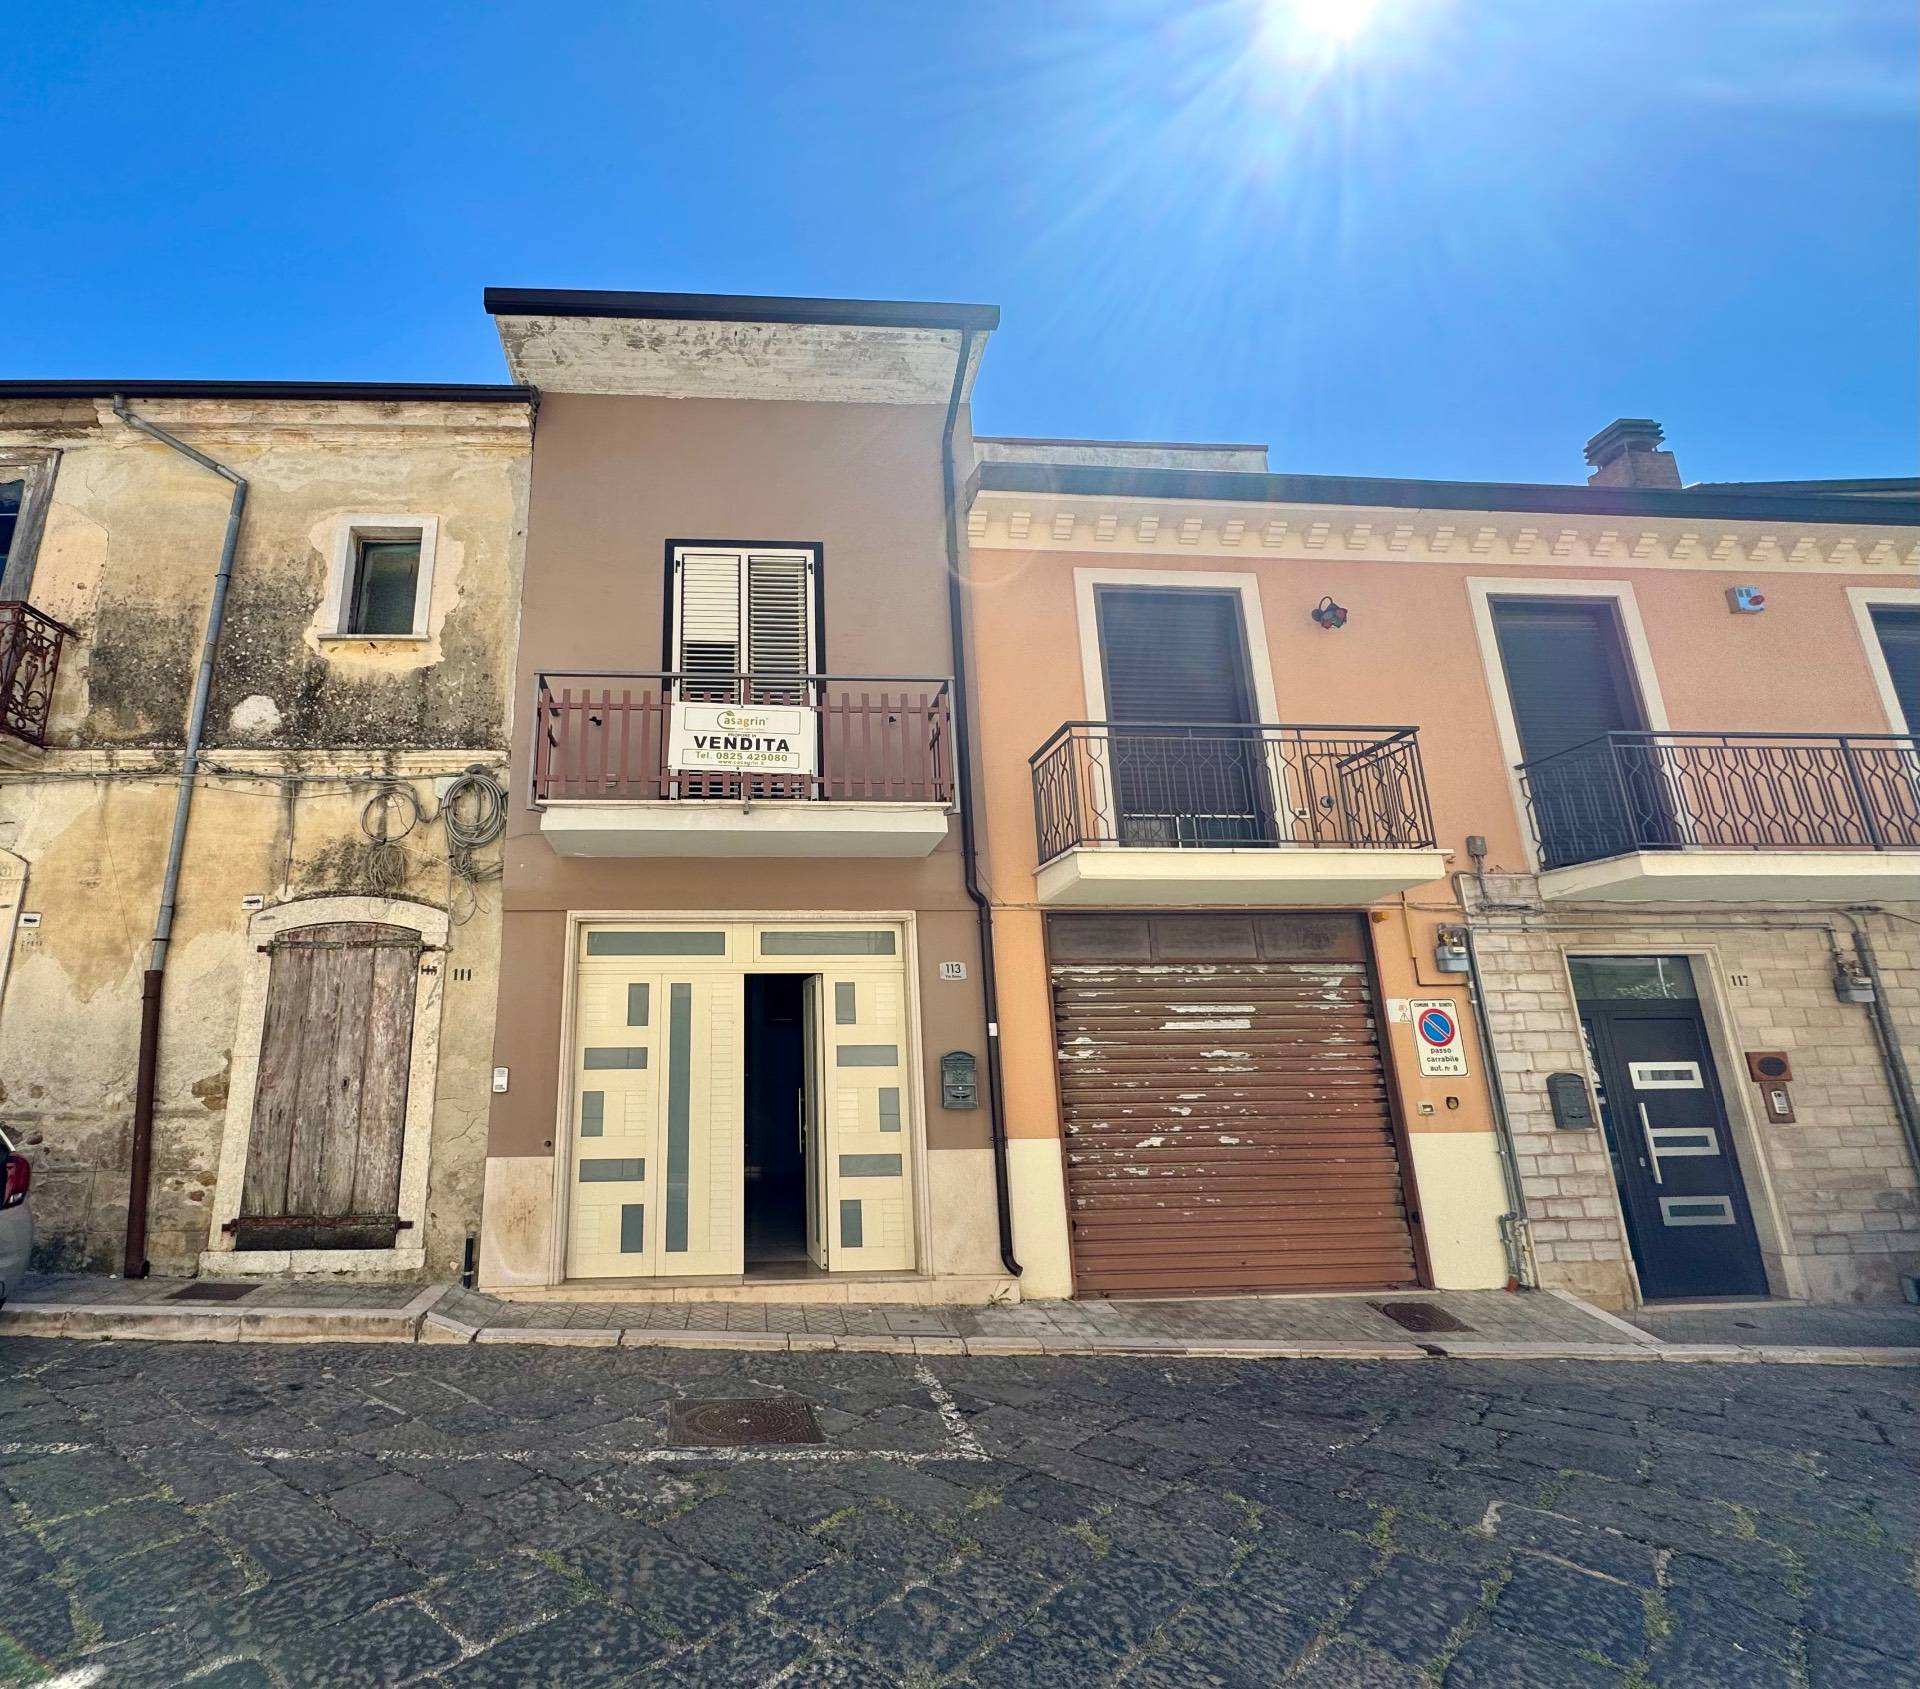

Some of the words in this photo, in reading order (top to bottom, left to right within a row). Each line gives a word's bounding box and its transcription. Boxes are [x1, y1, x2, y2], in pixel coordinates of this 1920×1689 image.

[693, 735, 790, 752] VENDITA
[696, 751, 712, 759] Tel.
[716, 752, 743, 760] 0825
[747, 753, 788, 762] 429080
[946, 963, 961, 973] 113
[453, 968, 472, 981] 111
[1731, 975, 1749, 986] 117
